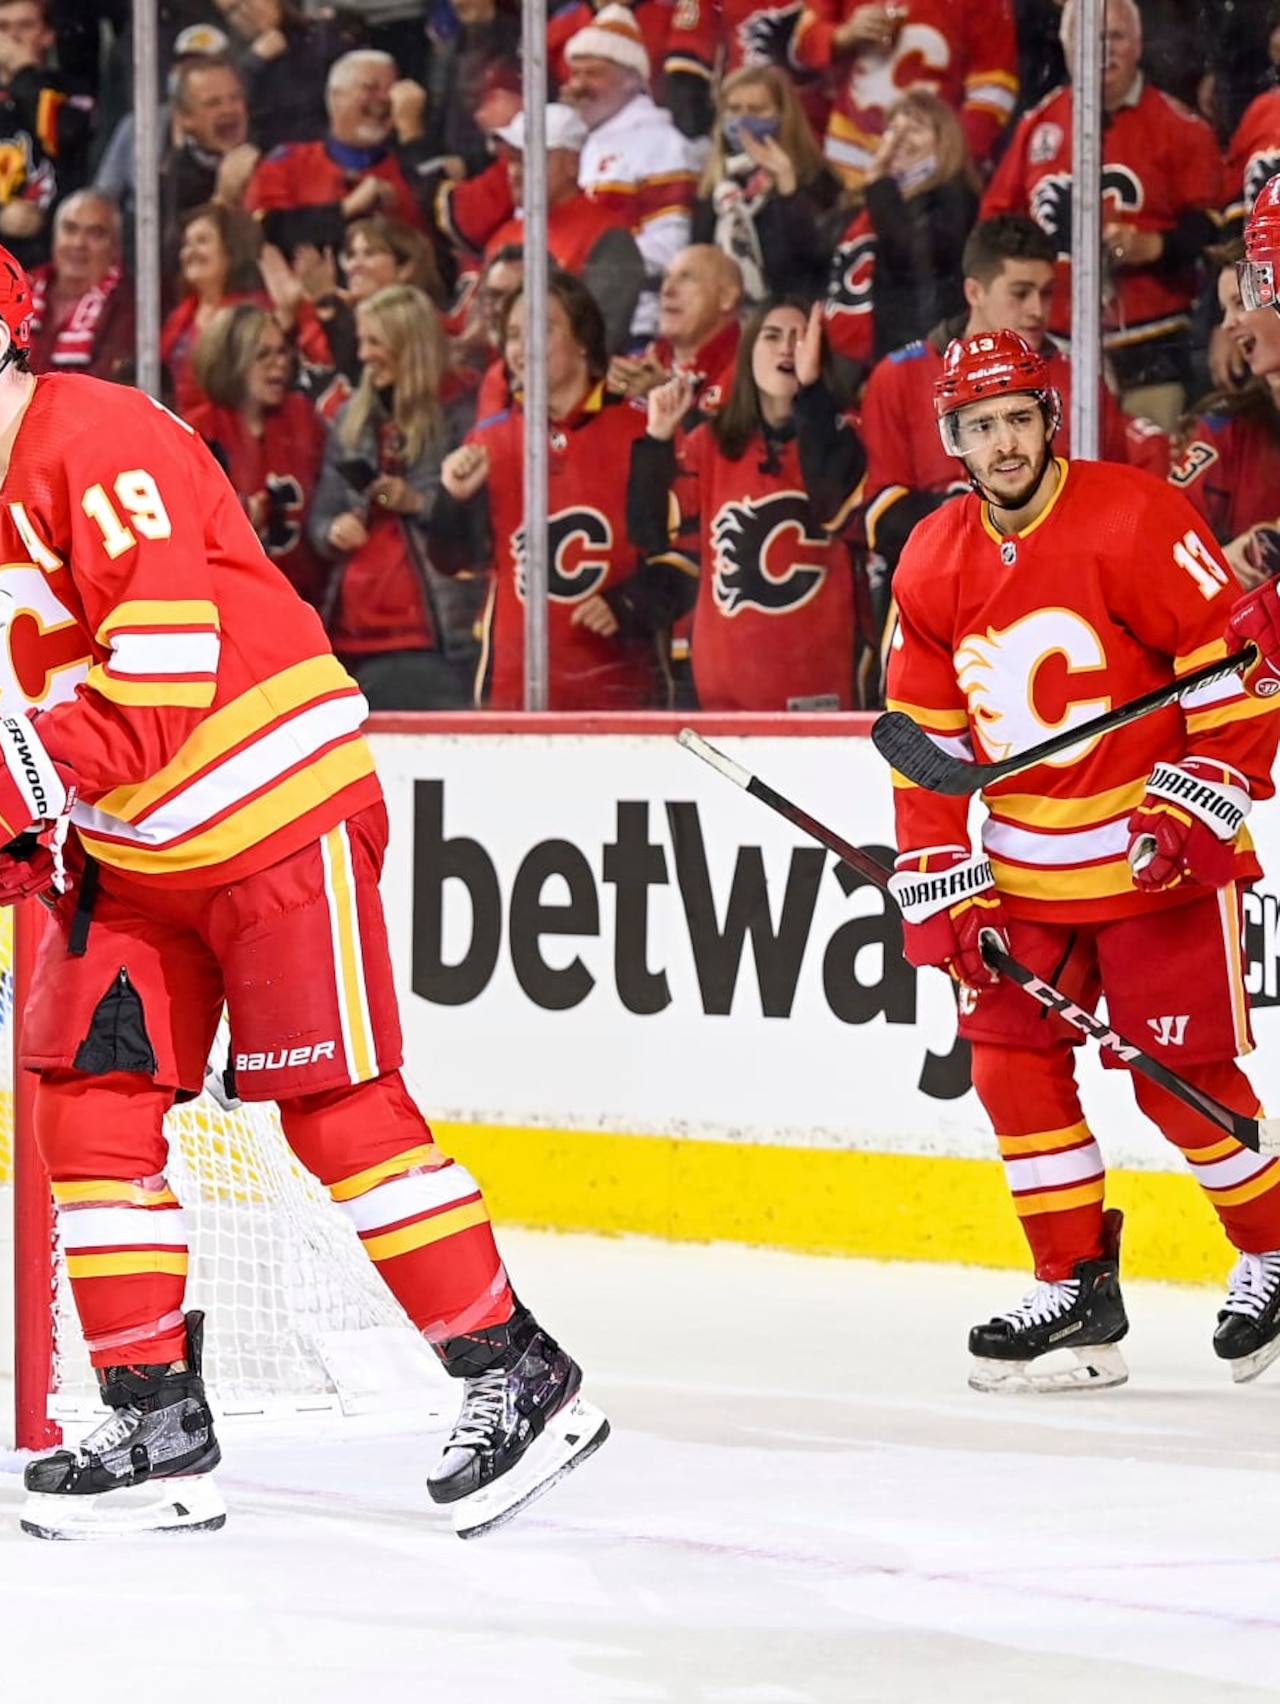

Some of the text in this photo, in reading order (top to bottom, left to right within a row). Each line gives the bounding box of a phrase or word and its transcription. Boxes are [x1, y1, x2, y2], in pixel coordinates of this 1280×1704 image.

[968, 337, 995, 355] 13
[81, 467, 172, 560] 19
[1146, 767, 1245, 831] WARRIOR
[897, 861, 995, 908] WARRIOR
[1023, 975, 1142, 1061] CCM
[235, 1040, 336, 1071] BAUER
